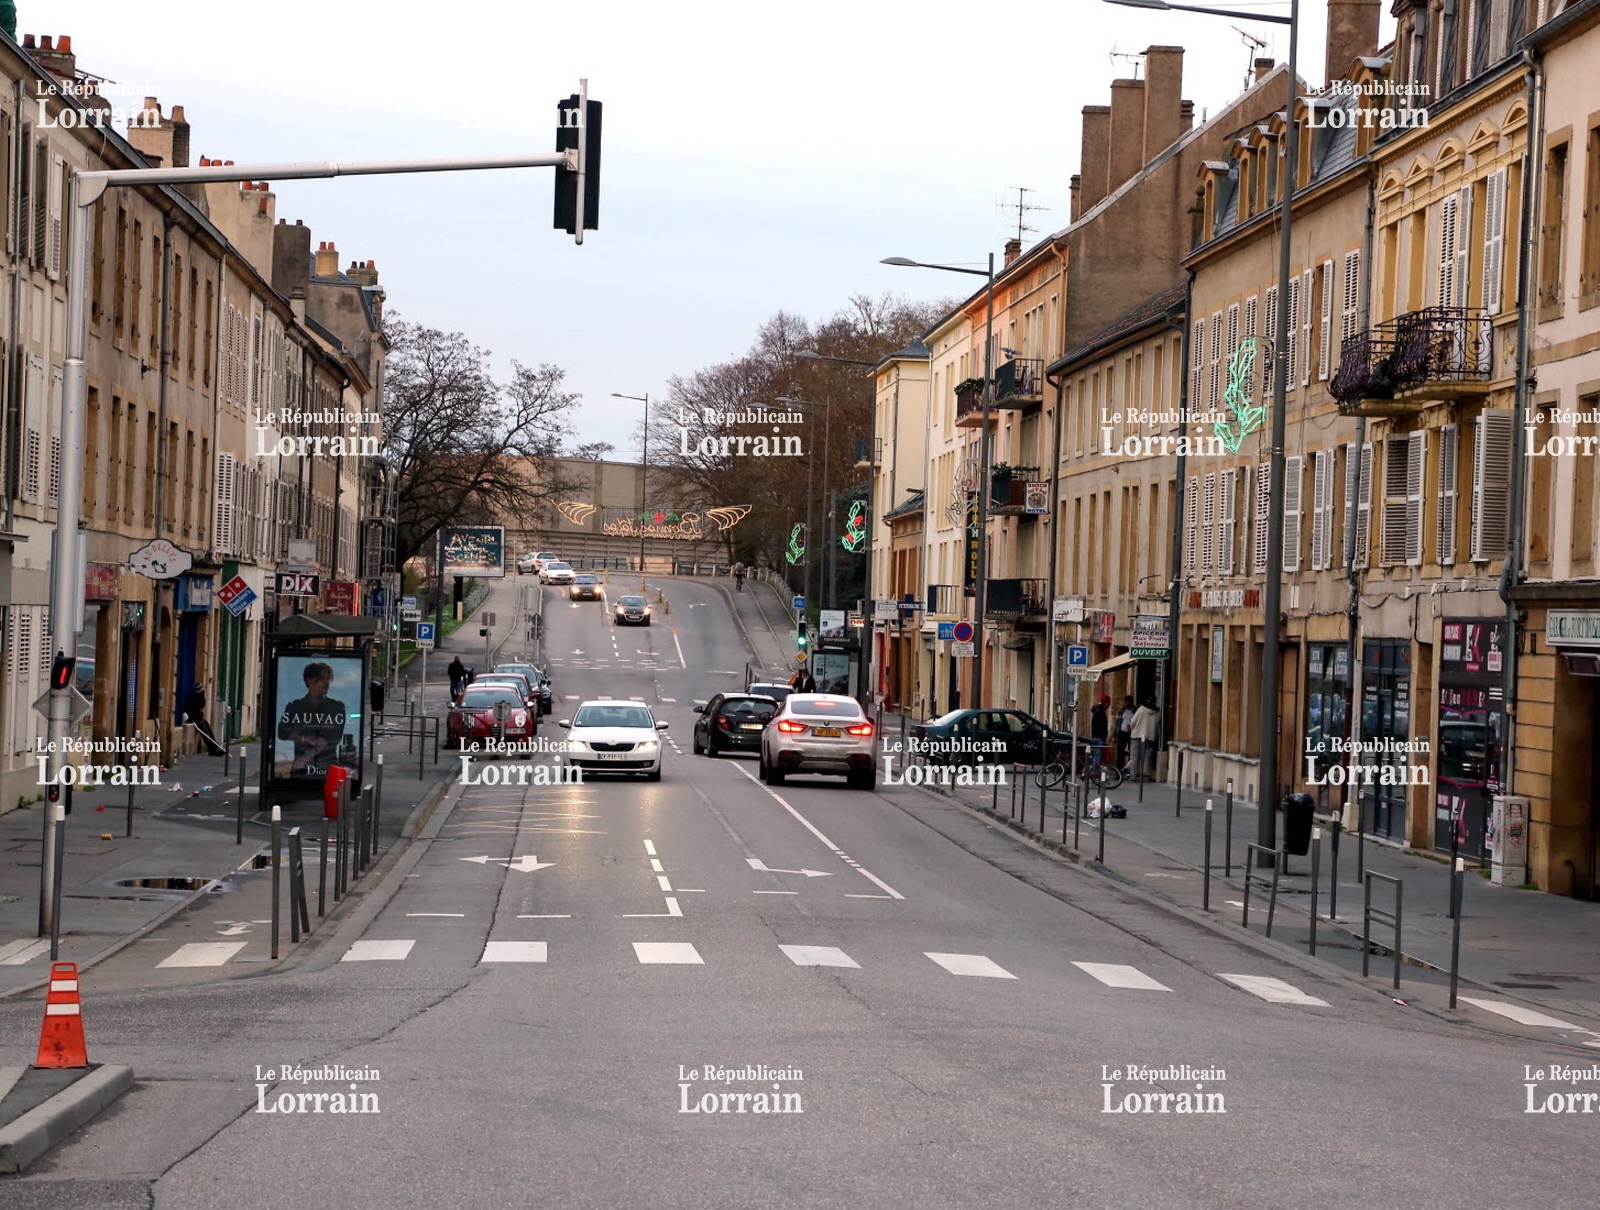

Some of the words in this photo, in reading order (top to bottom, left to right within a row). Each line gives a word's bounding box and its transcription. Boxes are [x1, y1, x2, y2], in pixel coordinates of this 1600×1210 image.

[970, 540, 979, 579] ROLL
[421, 626, 430, 637] P
[1073, 650, 1083, 662] P
[282, 713, 353, 725] SAUVAG
[306, 765, 327, 775] Dior
